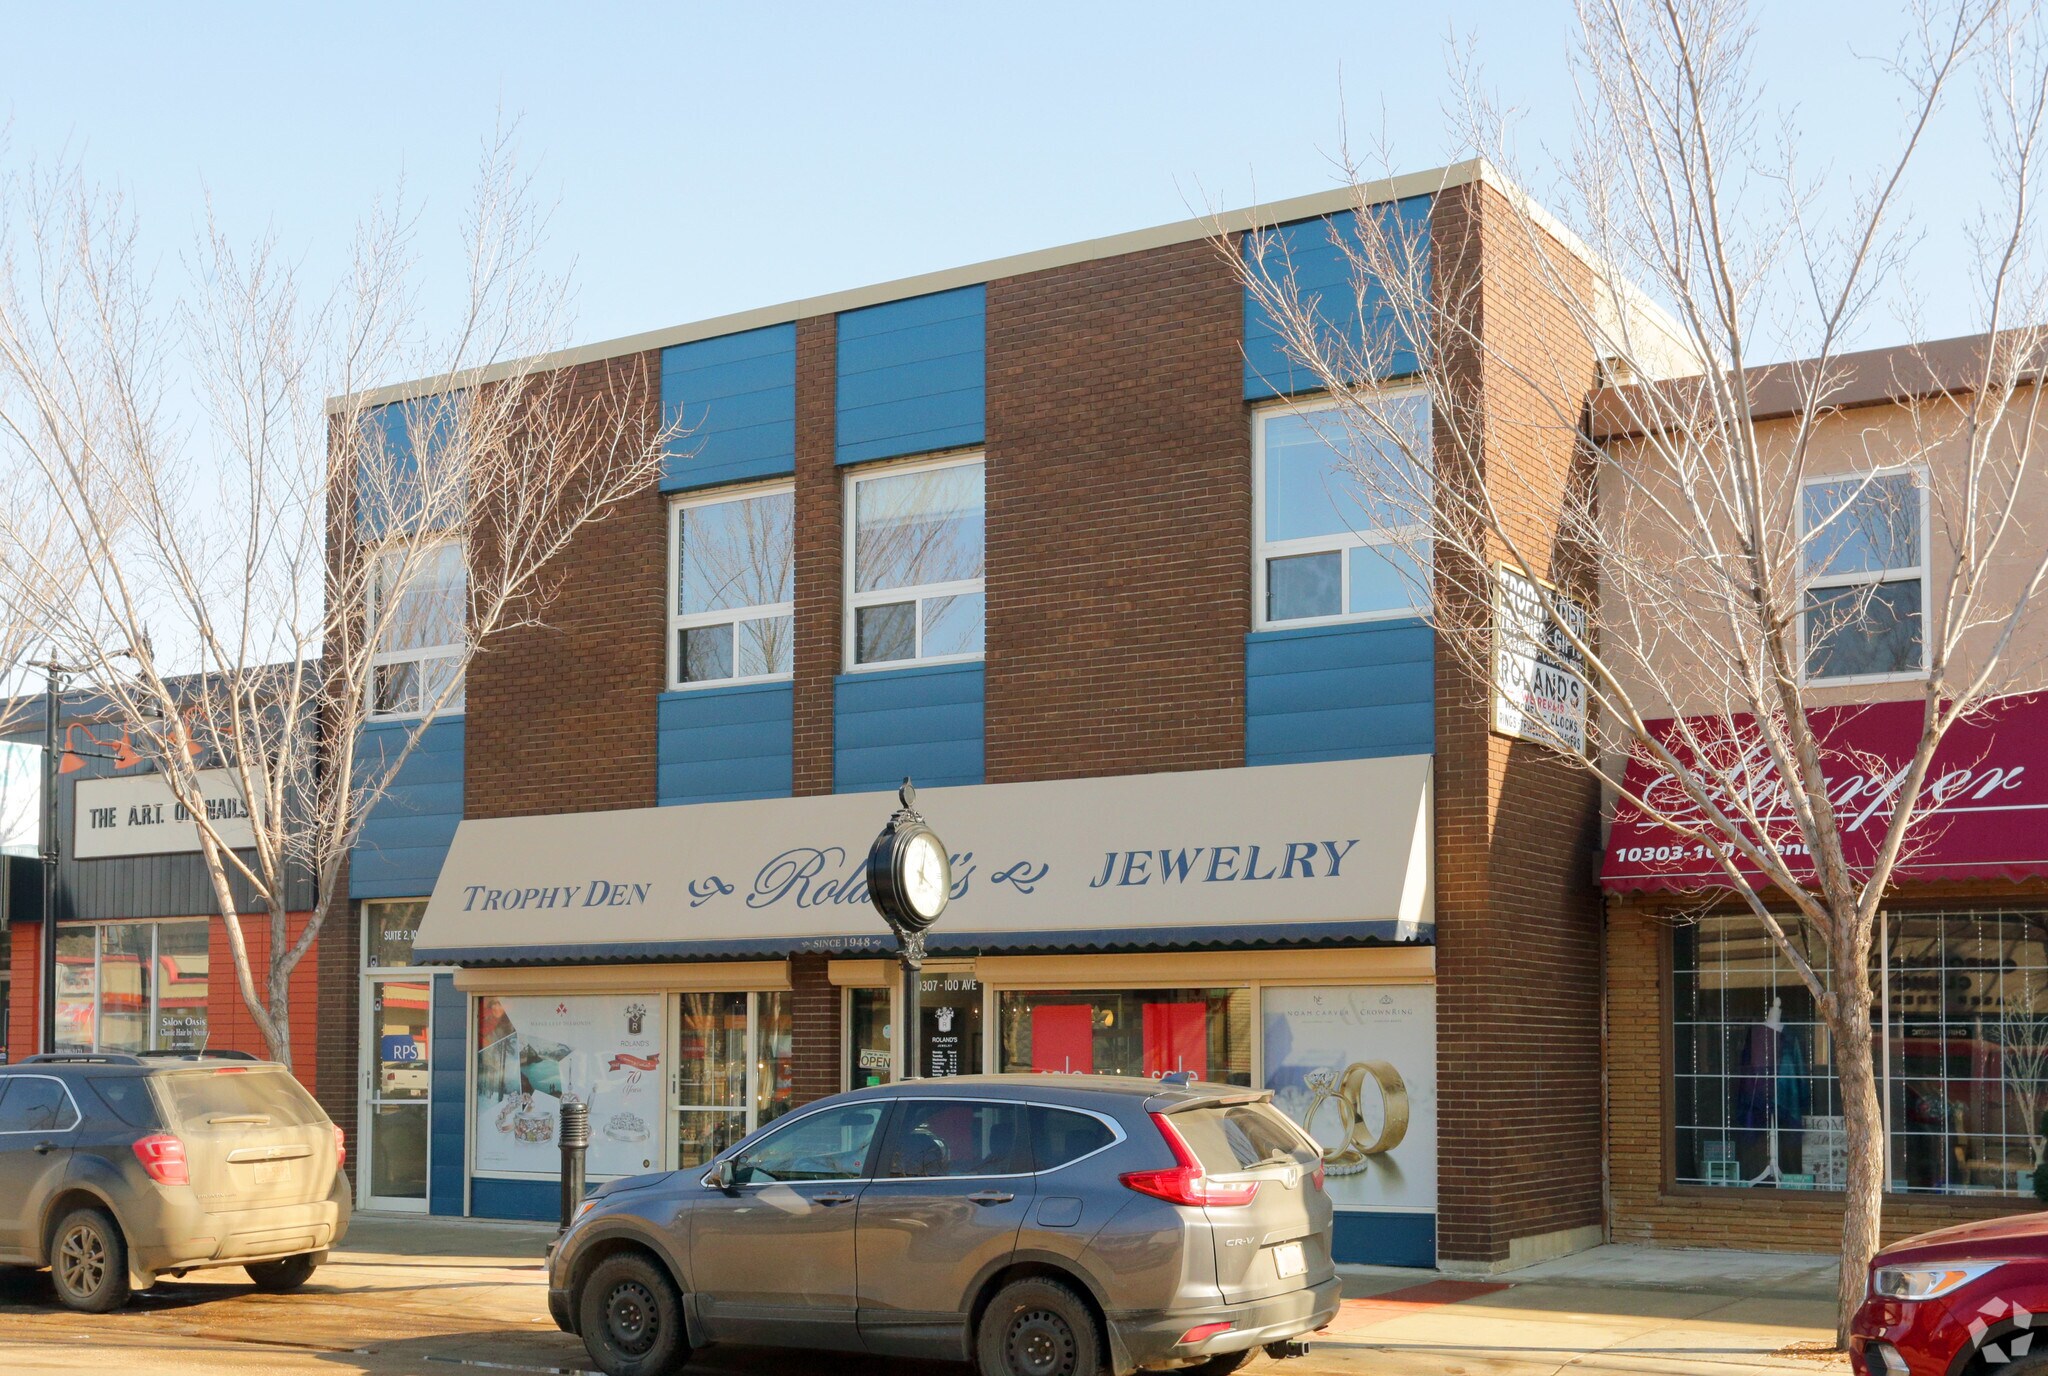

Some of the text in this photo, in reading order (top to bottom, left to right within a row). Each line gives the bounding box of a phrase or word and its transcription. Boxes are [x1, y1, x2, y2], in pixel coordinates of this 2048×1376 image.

[1501, 653, 1579, 708] ROLAND'S
[1550, 713, 1578, 733] CLOCKS
[89, 807, 117, 829] THE
[128, 804, 165, 826] A.R.T.
[206, 797, 250, 820] NAILS
[1089, 839, 1360, 888] JEWELRY
[745, 846, 977, 909] Rola's
[462, 880, 652, 912] TROPHY DEN
[384, 930, 402, 941] SUITE
[813, 937, 871, 948] SINCE 1948
[962, 979, 977, 991] AVE
[632, 1022, 639, 1031] R
[394, 1045, 417, 1059] RPS
[861, 1055, 891, 1068] OPEN
[626, 1070, 641, 1084] 70
[1225, 1236, 1255, 1247] CR-V
